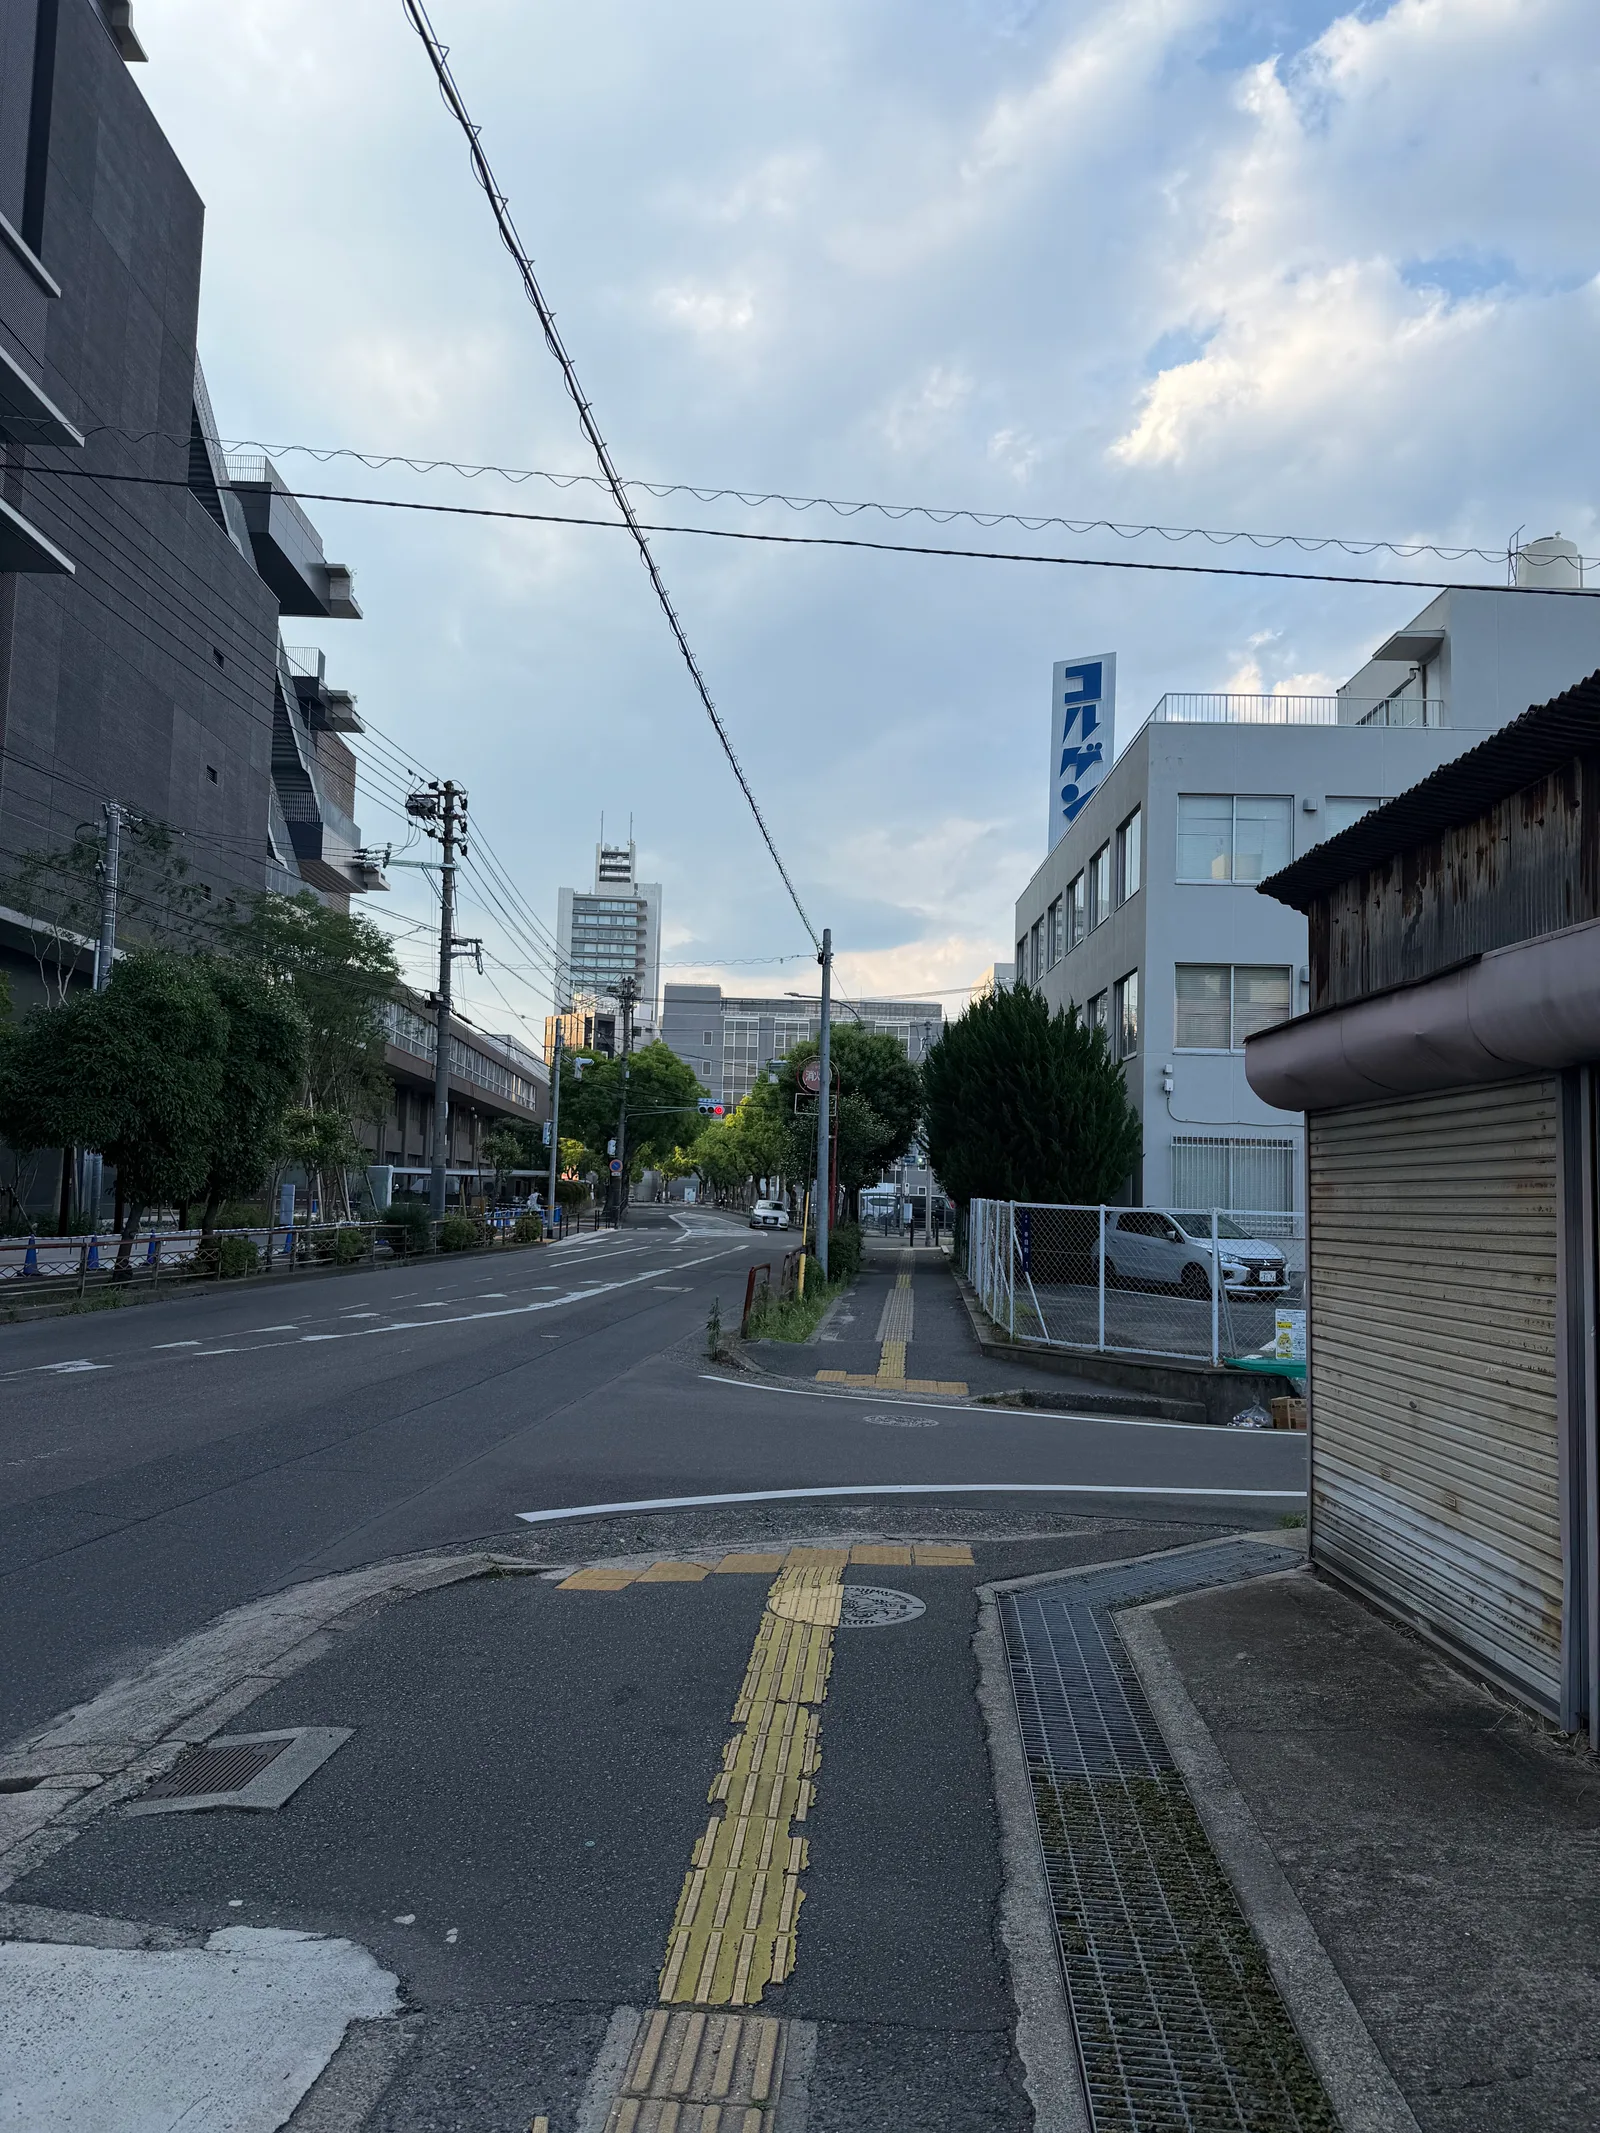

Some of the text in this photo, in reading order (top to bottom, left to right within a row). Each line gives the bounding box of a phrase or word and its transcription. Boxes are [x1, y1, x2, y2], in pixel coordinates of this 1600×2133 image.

[1060, 662, 1103, 822] コルゲン
[805, 1070, 821, 1082] 消火
